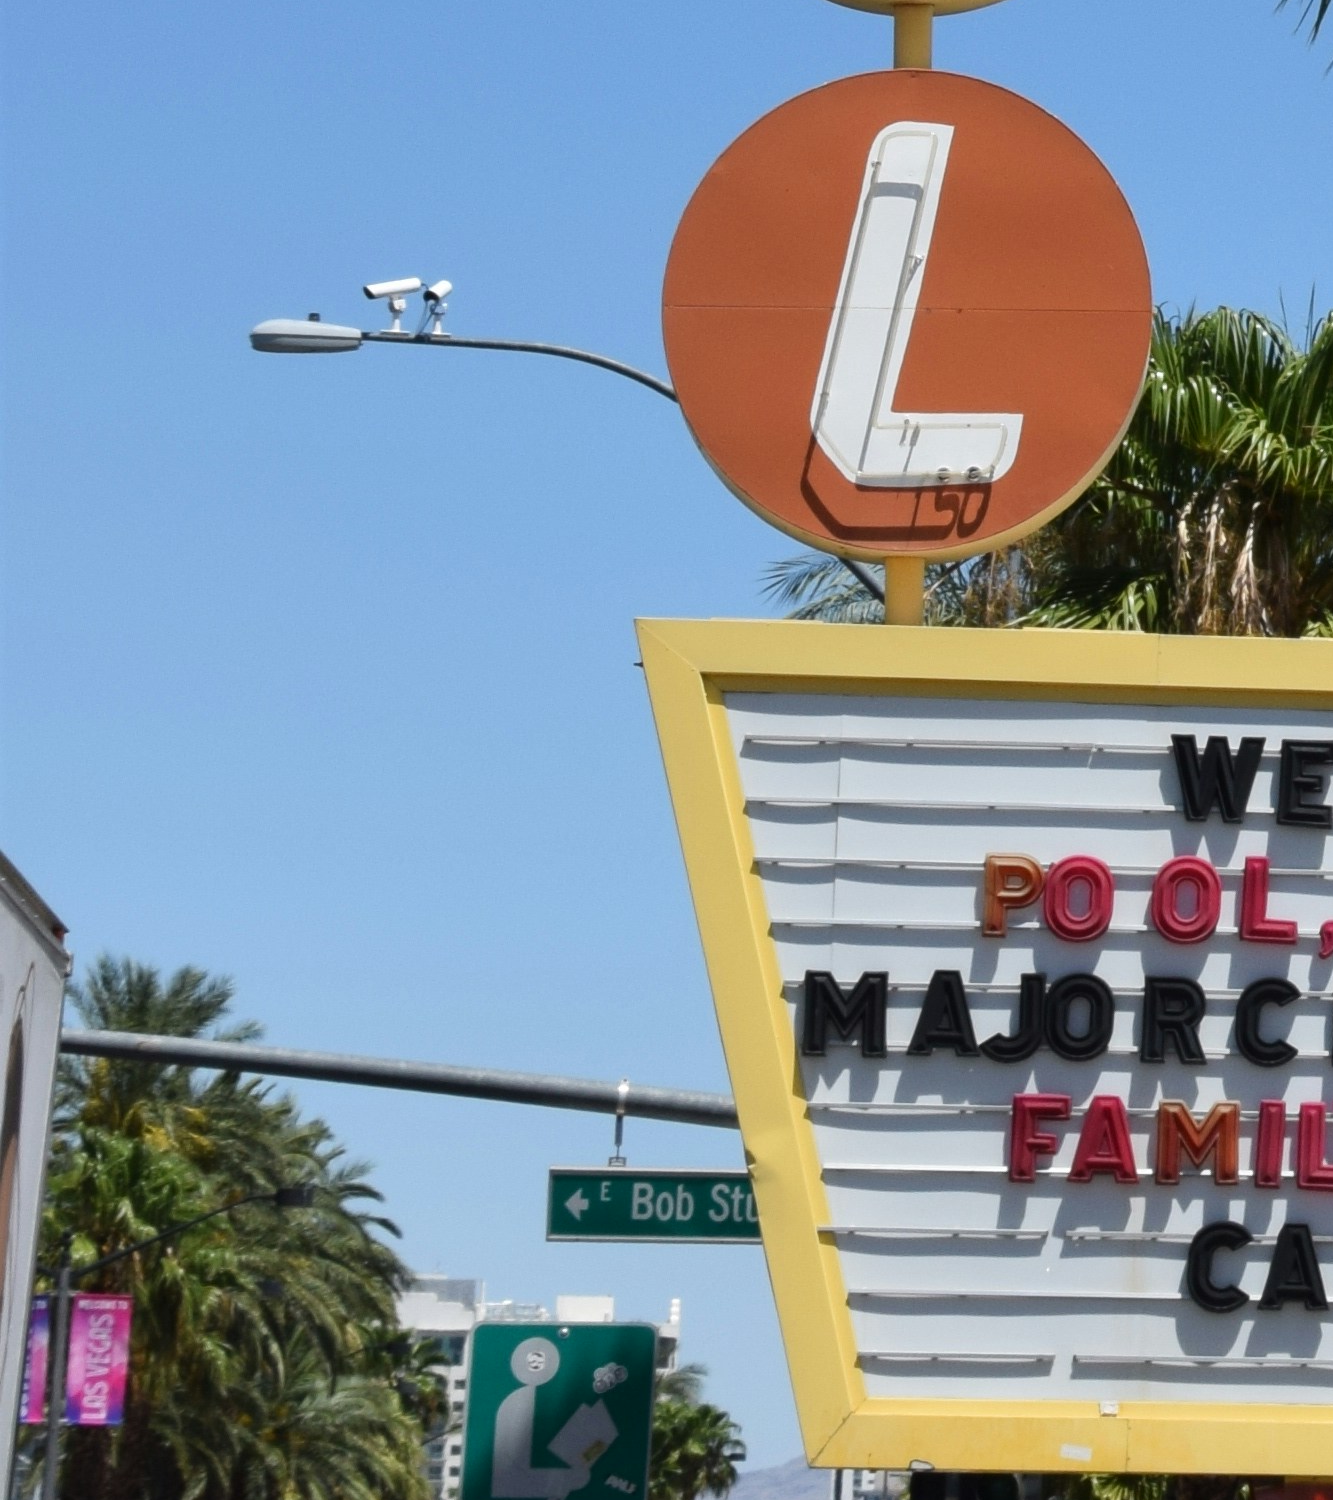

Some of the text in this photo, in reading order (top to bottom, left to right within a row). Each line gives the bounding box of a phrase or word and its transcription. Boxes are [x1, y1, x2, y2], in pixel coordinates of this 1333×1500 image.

[797, 969, 1209, 1068] MAJOR
[601, 1181, 612, 1201] E
[631, 1182, 694, 1222] Bob
[80, 1313, 114, 1420] LAS VEGAS
